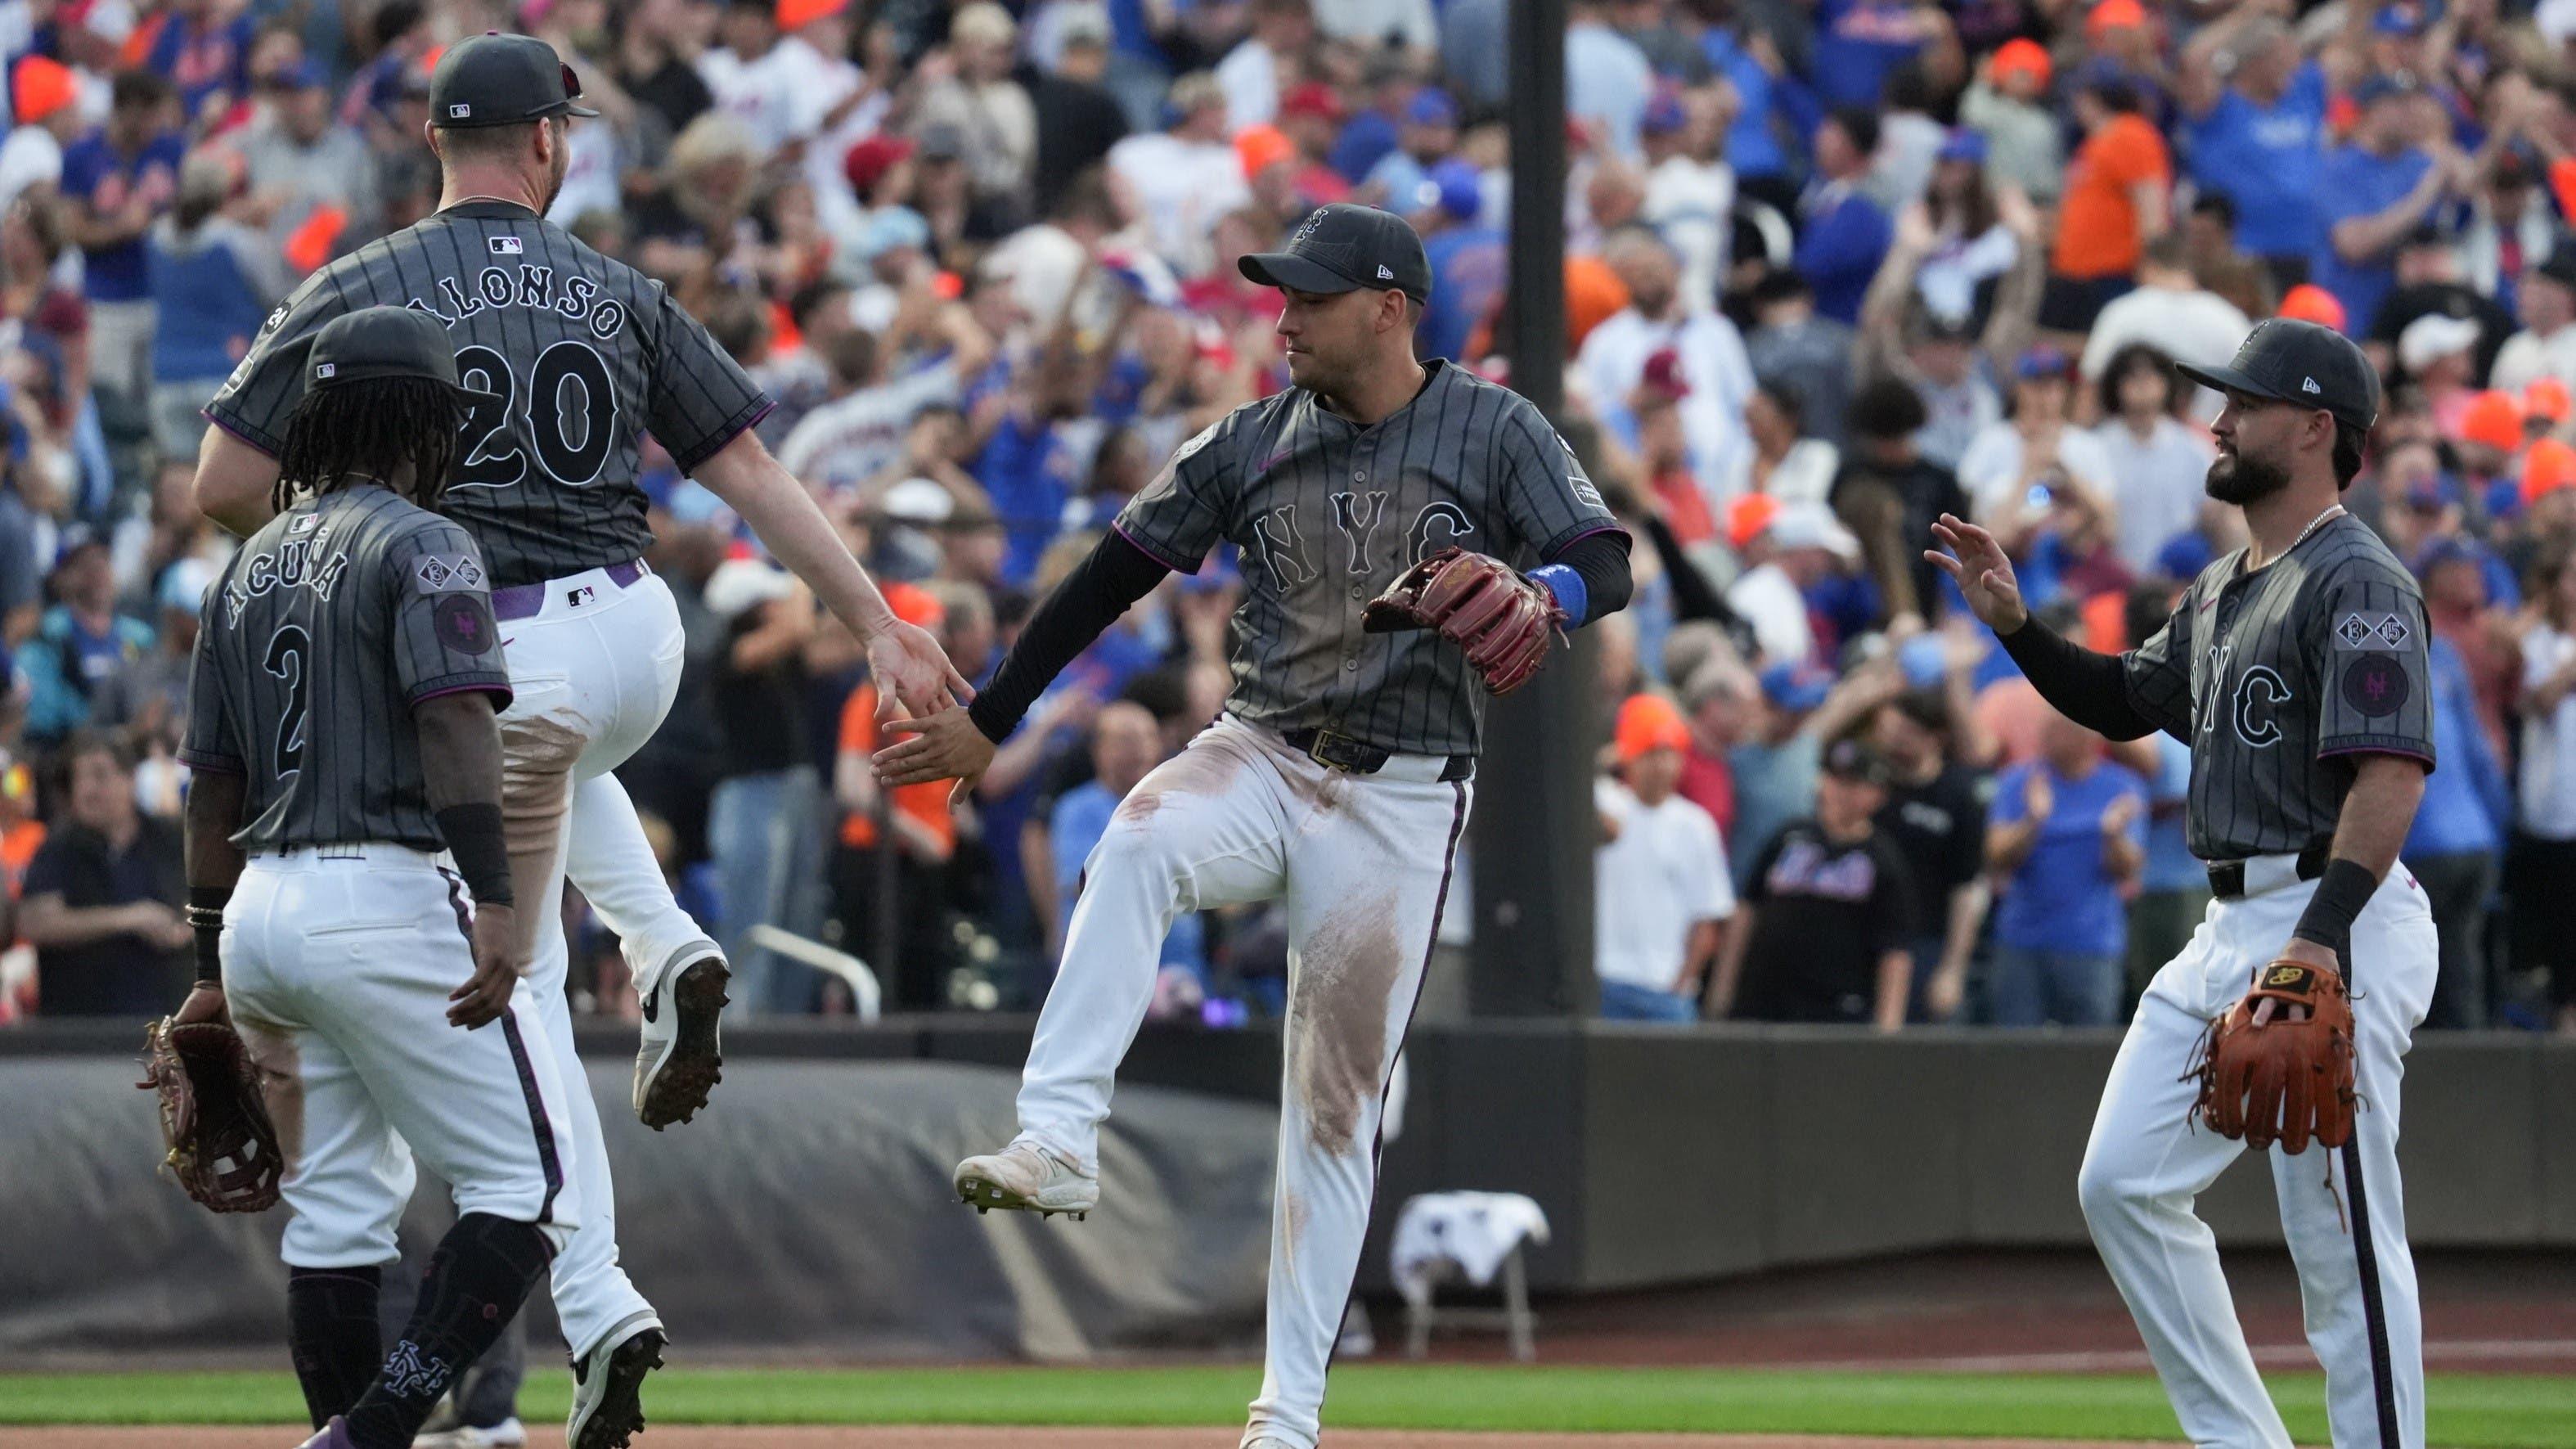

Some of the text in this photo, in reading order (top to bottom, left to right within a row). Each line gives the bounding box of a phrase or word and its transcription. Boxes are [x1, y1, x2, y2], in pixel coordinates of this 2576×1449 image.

[267, 307, 288, 329] 24
[447, 340, 619, 492] 20
[223, 527, 348, 630] ACUÑA
[262, 624, 311, 781] 2
[383, 1339, 451, 1397] NY
